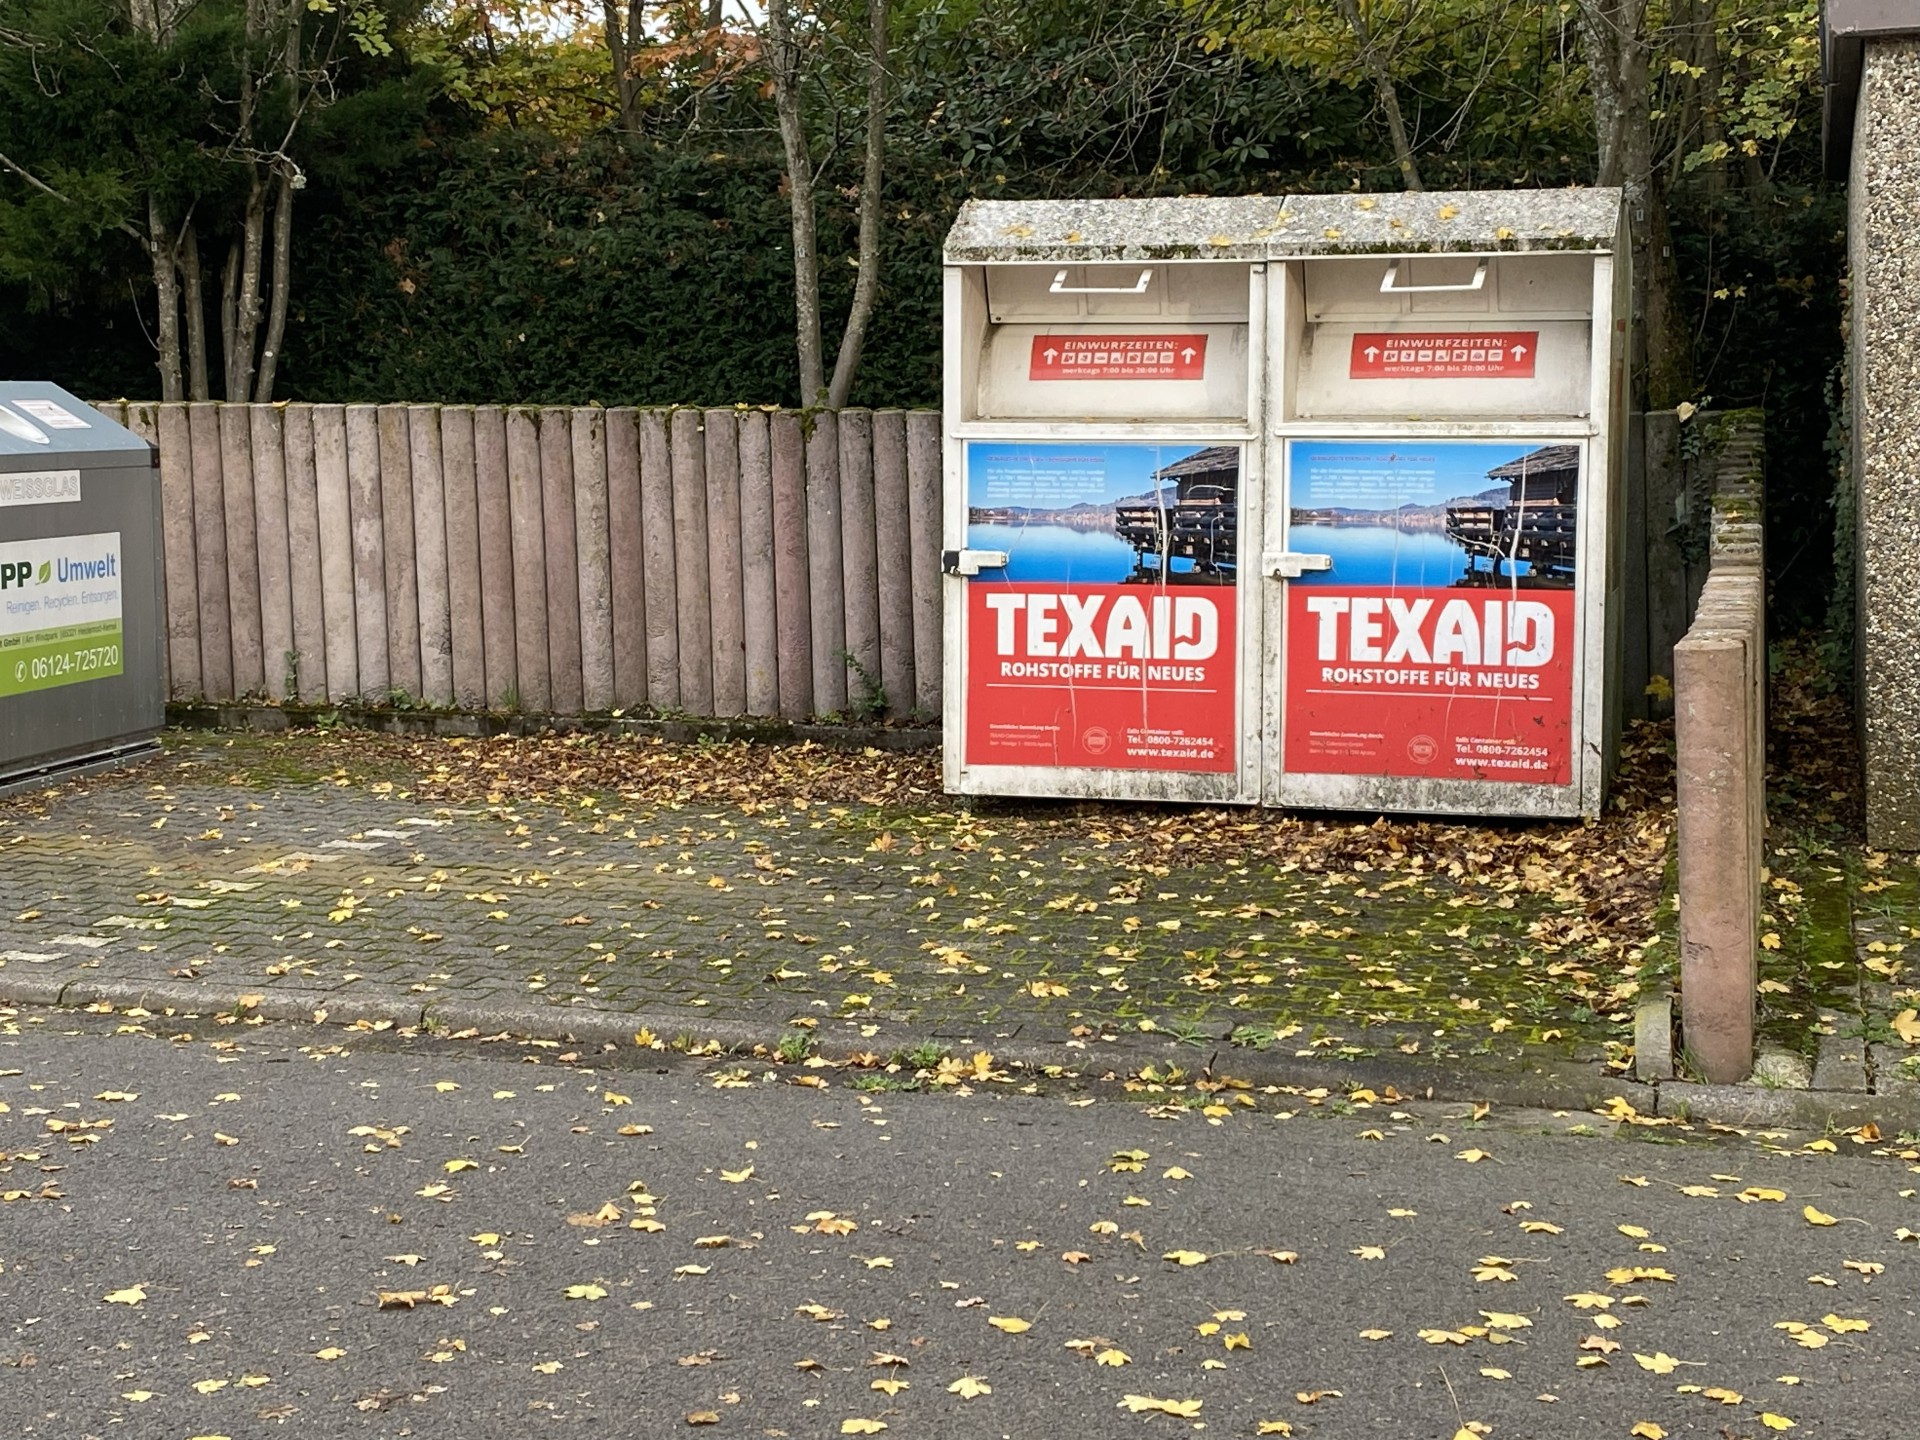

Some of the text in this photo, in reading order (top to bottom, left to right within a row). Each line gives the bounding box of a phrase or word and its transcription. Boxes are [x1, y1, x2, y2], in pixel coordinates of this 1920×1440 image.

[1064, 341, 1179, 350] EINWURFZEITEN:
[1386, 338, 1508, 348] EINWURFZEITEN:
[0, 475, 79, 500] WEISSGLAS
[57, 553, 116, 582] Umwelt
[986, 593, 1218, 660] TEXAID
[1307, 596, 1555, 667] TEXAID
[32, 645, 118, 679] 06124-725720
[1001, 661, 1205, 682] ROHSTOFFE FÜR NEUES
[1322, 667, 1540, 689] ROHSTOFFE FÜR NEUES
[1127, 735, 1214, 746] Tel. 0800-7262454
[1455, 744, 1548, 757] Tel. 0800-7262454
[1126, 748, 1214, 759] www.texaid.de
[1455, 757, 1548, 770] www.texaid.de
